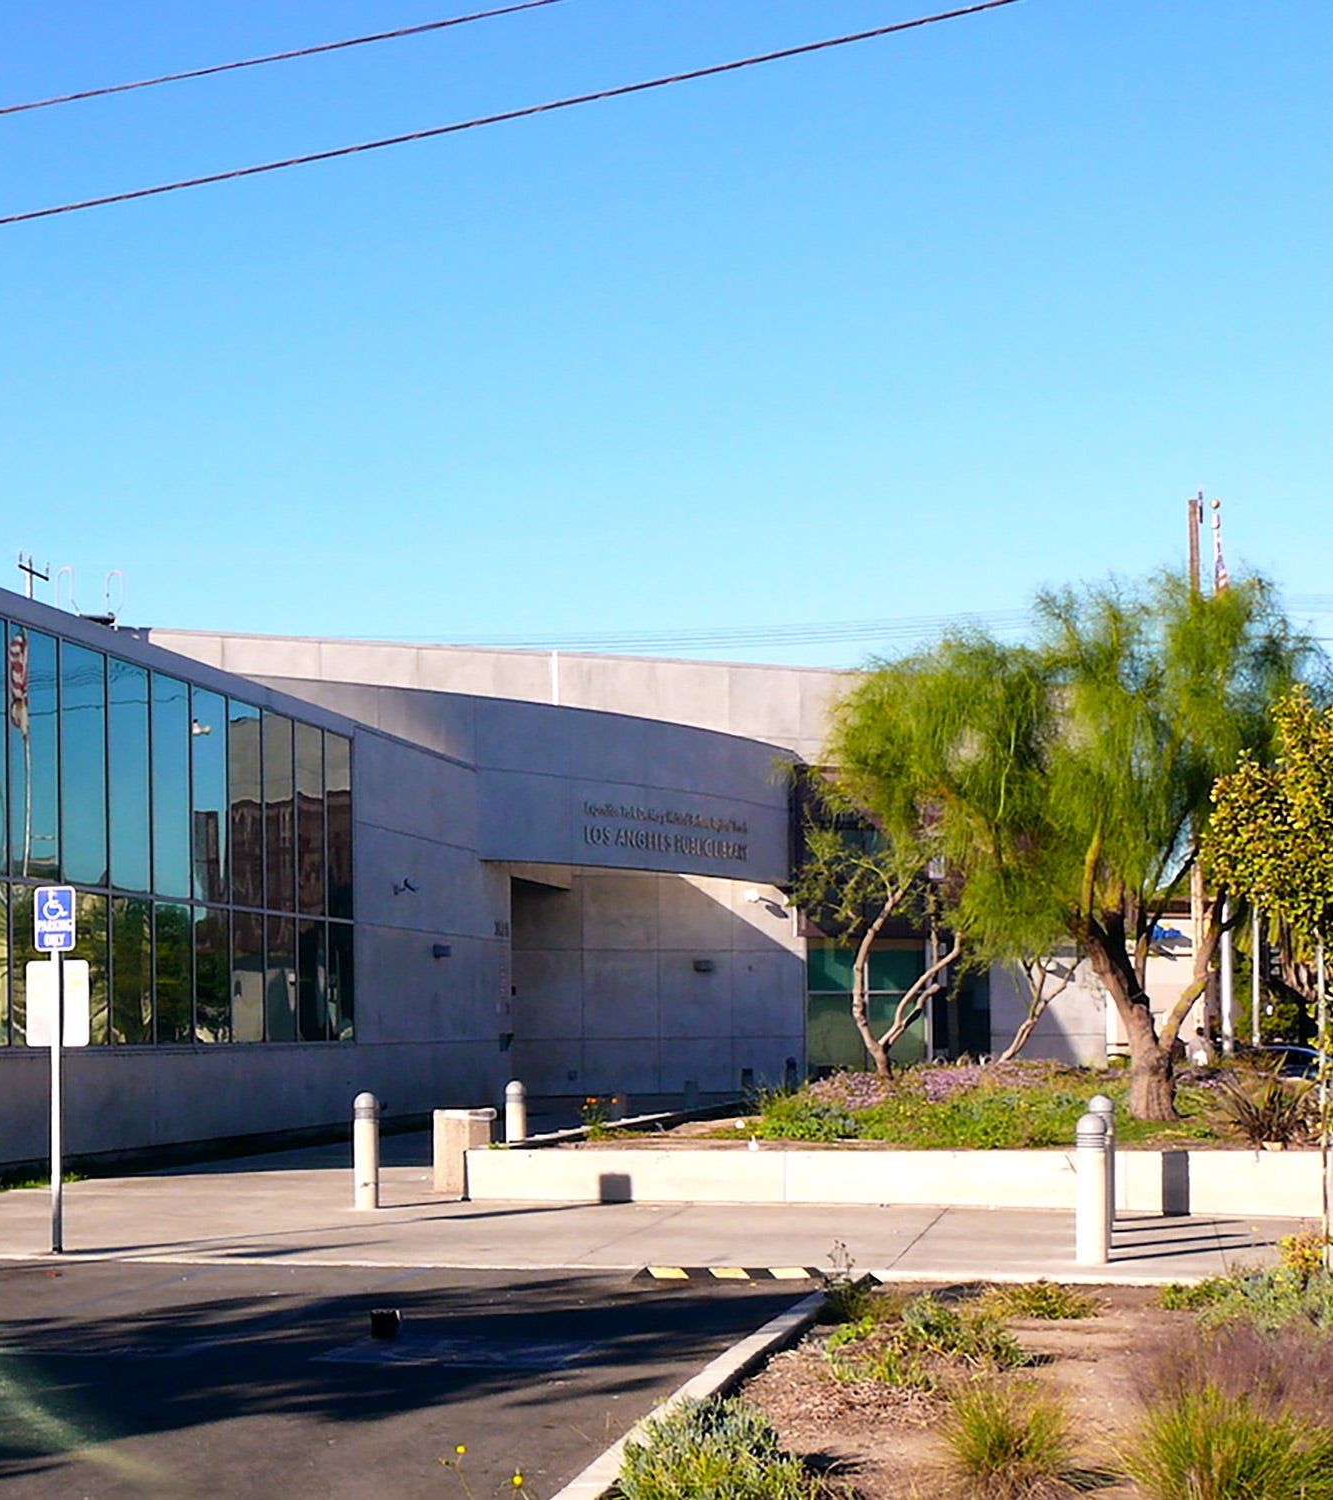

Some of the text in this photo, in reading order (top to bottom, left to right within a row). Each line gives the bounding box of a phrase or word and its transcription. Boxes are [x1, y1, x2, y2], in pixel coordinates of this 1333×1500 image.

[584, 826, 611, 847] LOS
[615, 829, 672, 852] ANGELES
[673, 833, 711, 858] PUBLIC
